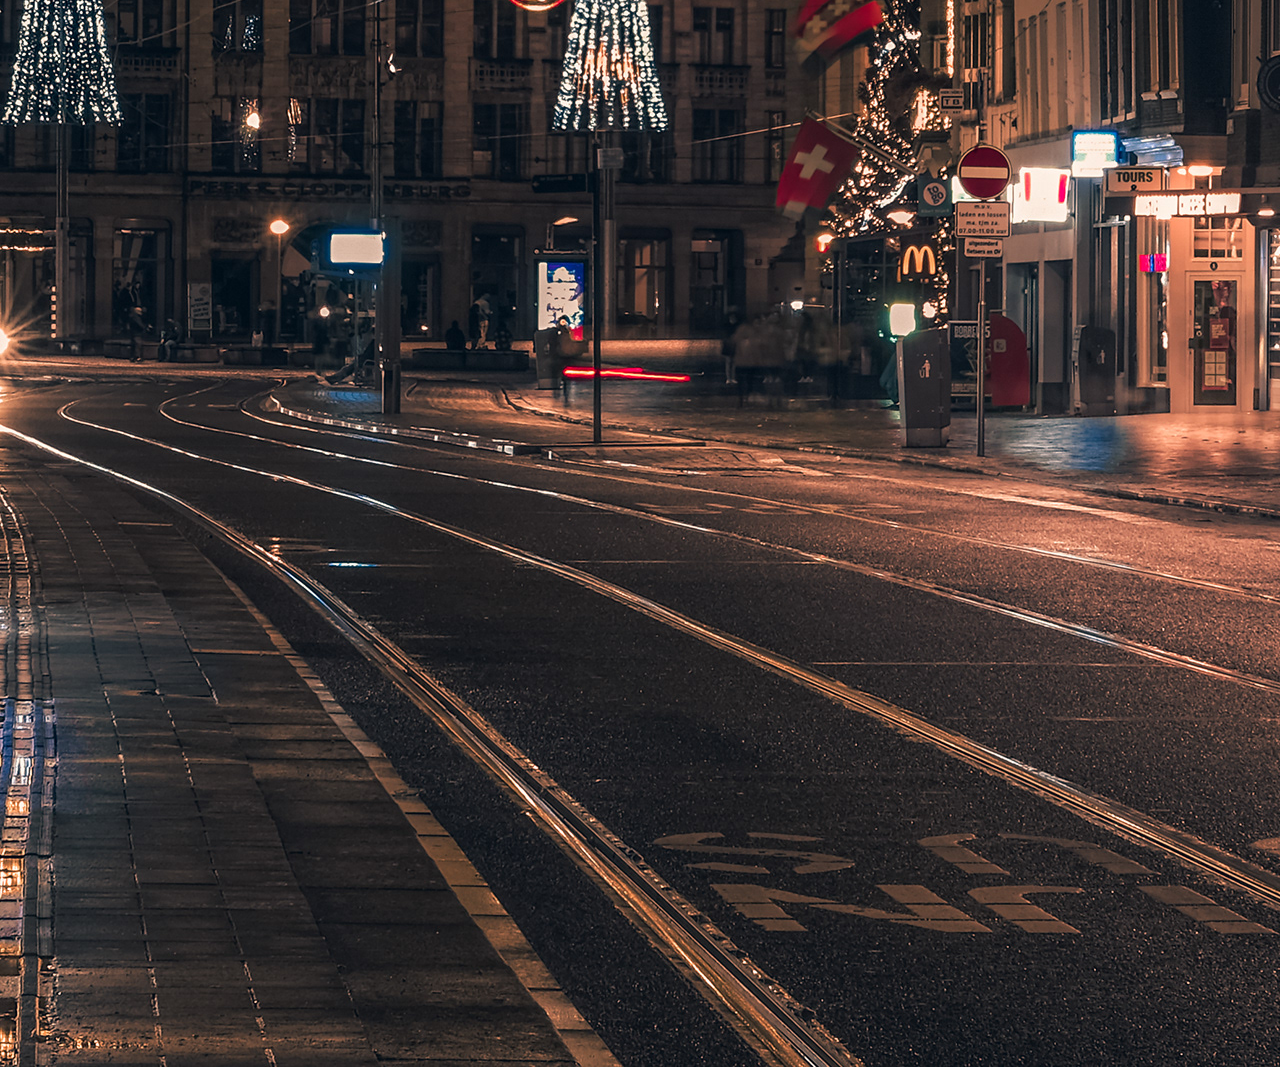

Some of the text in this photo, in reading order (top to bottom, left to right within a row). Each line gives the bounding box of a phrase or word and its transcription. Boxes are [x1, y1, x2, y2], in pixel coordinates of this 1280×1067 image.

[1115, 170, 1154, 184] TOURS
[189, 179, 251, 195] PEEK
[282, 183, 472, 199] CLOPPNBURG
[931, 191, 945, 205] go
